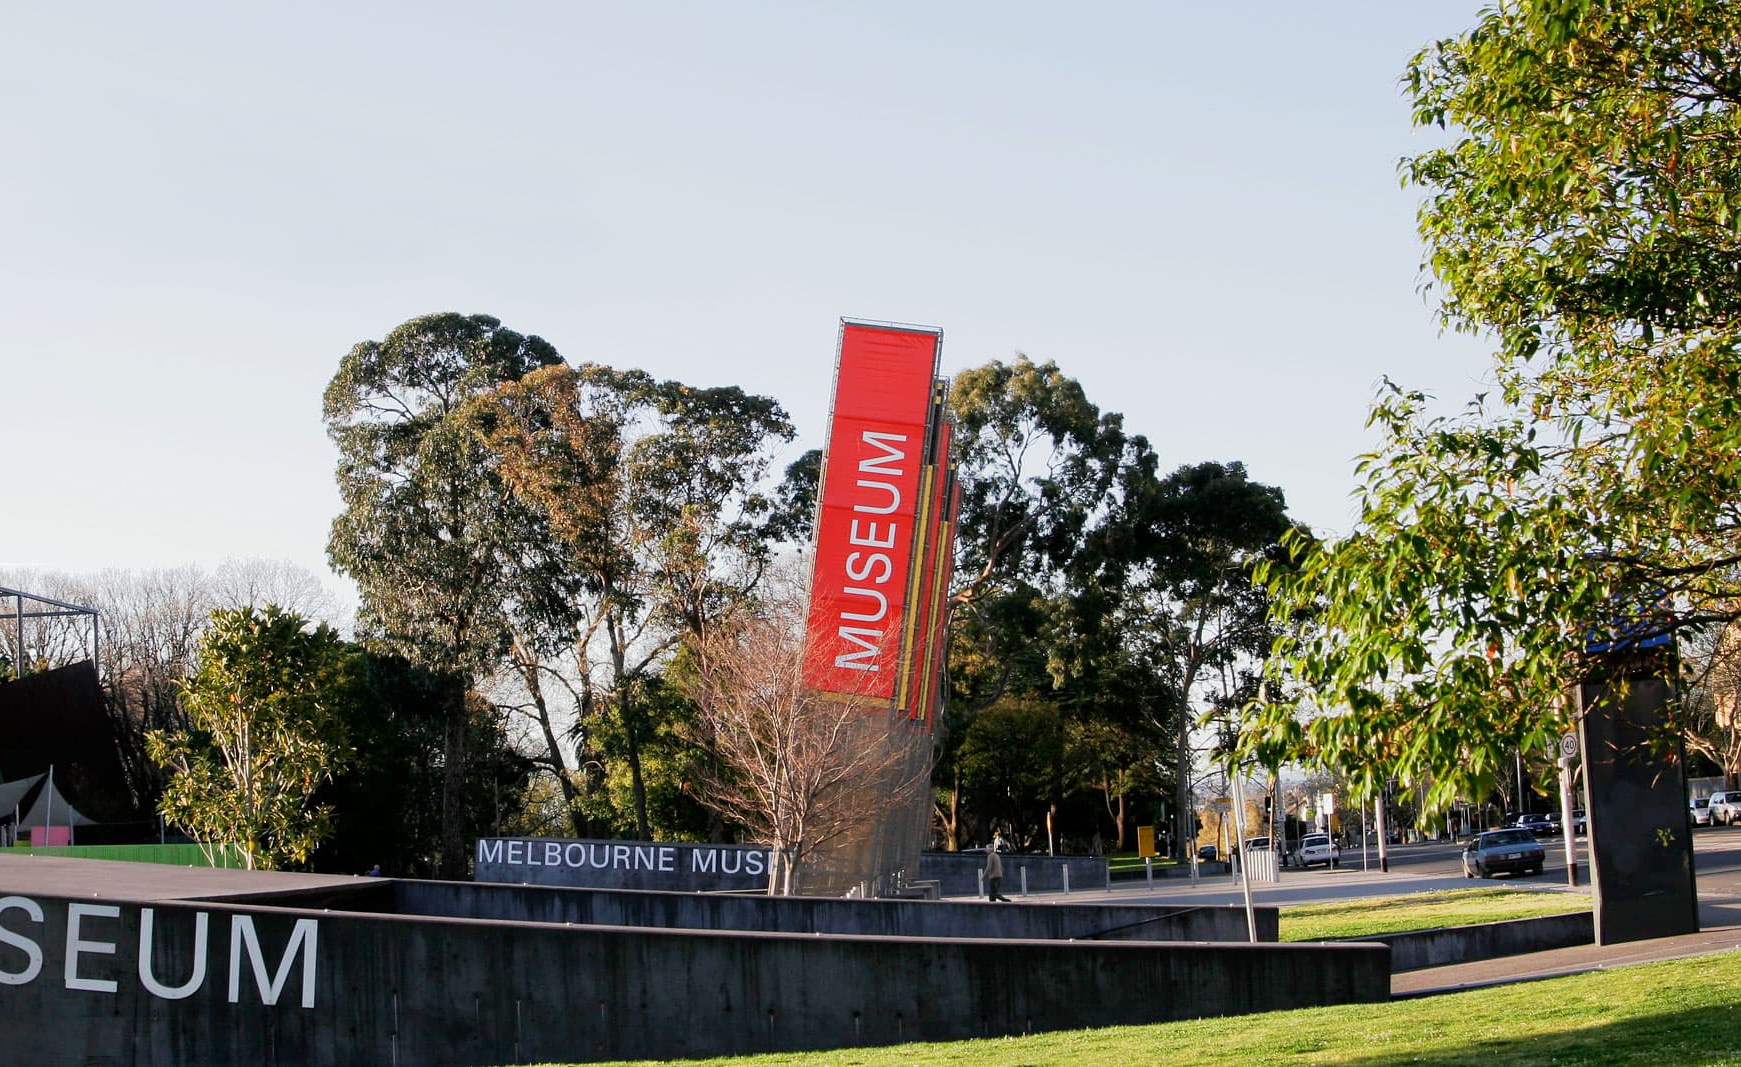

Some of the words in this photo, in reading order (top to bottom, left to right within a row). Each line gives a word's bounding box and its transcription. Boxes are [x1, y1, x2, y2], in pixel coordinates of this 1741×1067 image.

[835, 431, 907, 671] MUSEUM
[1565, 740, 1574, 750] 40
[479, 839, 674, 871] MELBOURNE
